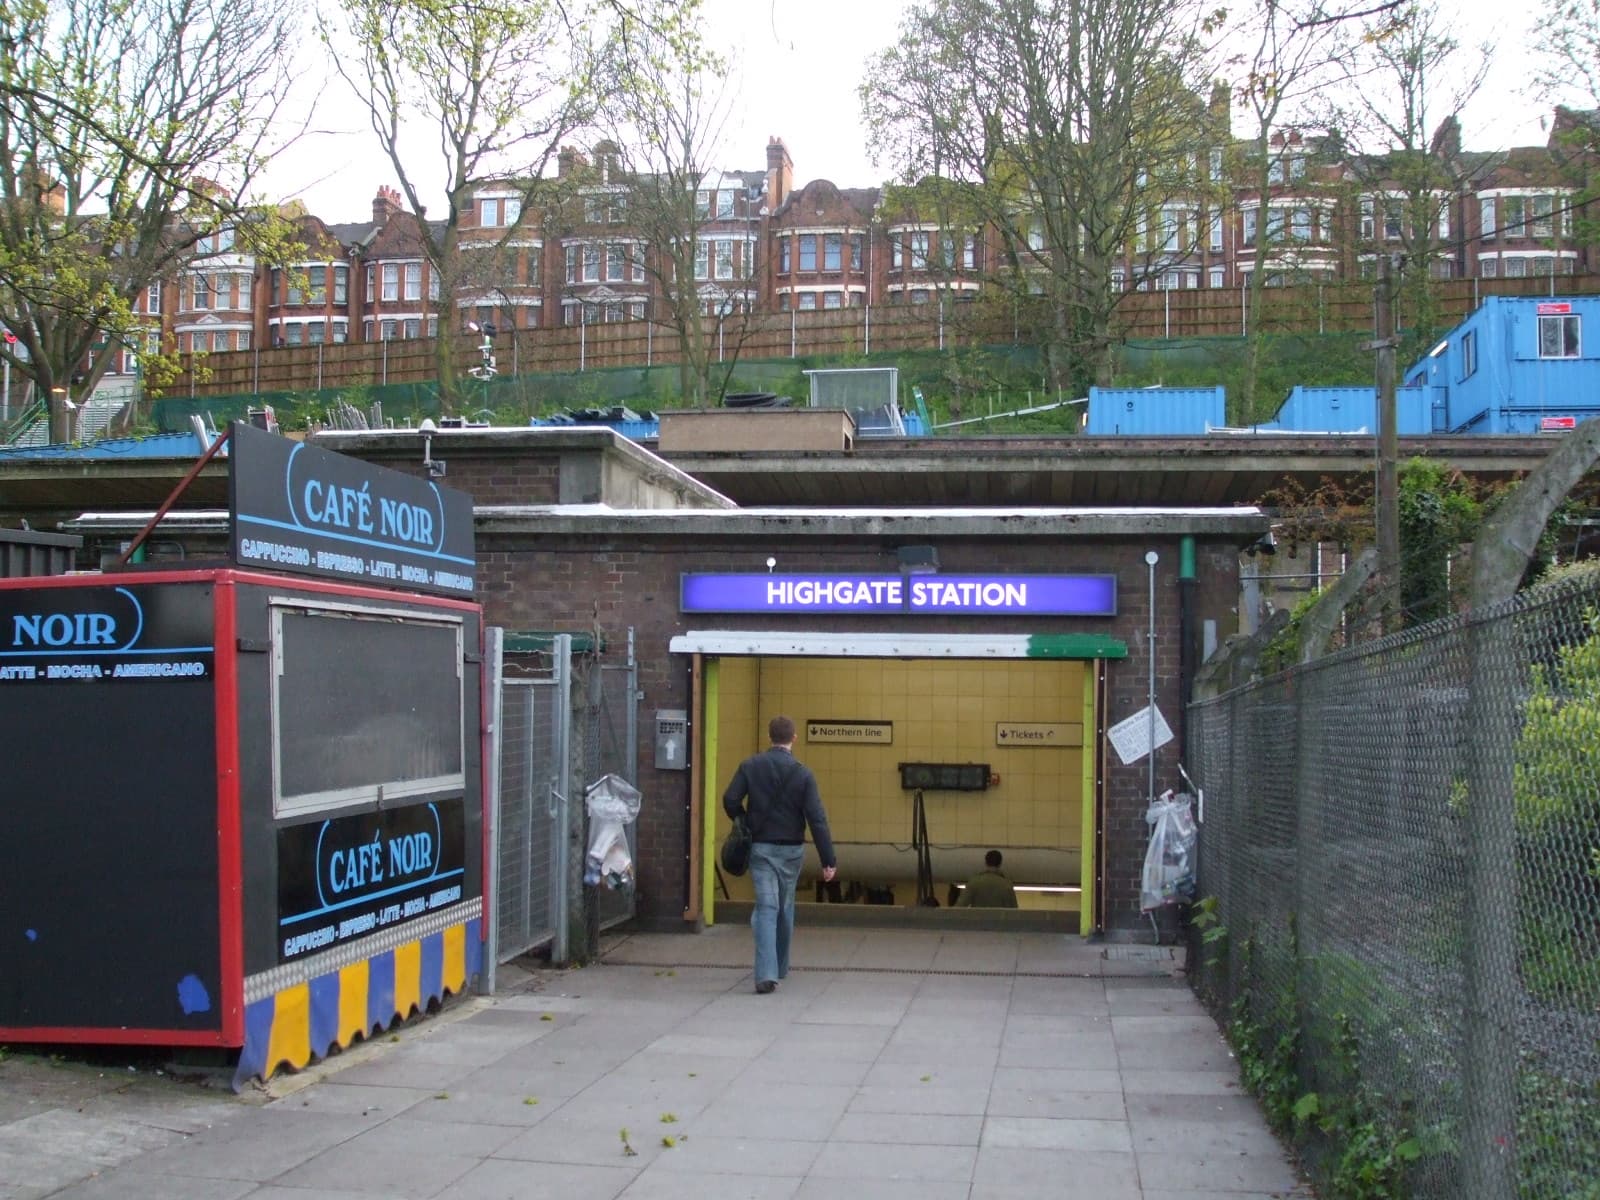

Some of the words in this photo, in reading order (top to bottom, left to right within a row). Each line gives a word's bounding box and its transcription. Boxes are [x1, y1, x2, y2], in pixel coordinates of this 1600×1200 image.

[304, 479, 374, 534] CAFÉ
[380, 498, 434, 545] NOIR
[241, 538, 310, 566] CAPPUCCINO
[370, 560, 397, 579] LATTE
[401, 565, 429, 584] MOCHA
[767, 582, 903, 605] HIGHGATE
[912, 583, 1027, 606] STATION
[12, 613, 117, 646] NOIR
[47, 664, 102, 678] MOCHA
[113, 662, 205, 677] AMERICANO
[819, 727, 862, 737] Northern
[865, 728, 882, 737] line
[1010, 730, 1044, 739] Tickets
[330, 828, 384, 893] CAFÉ
[388, 832, 432, 878] NOIR
[284, 925, 335, 957] CAPPUCCINO
[380, 904, 400, 925] LATTE
